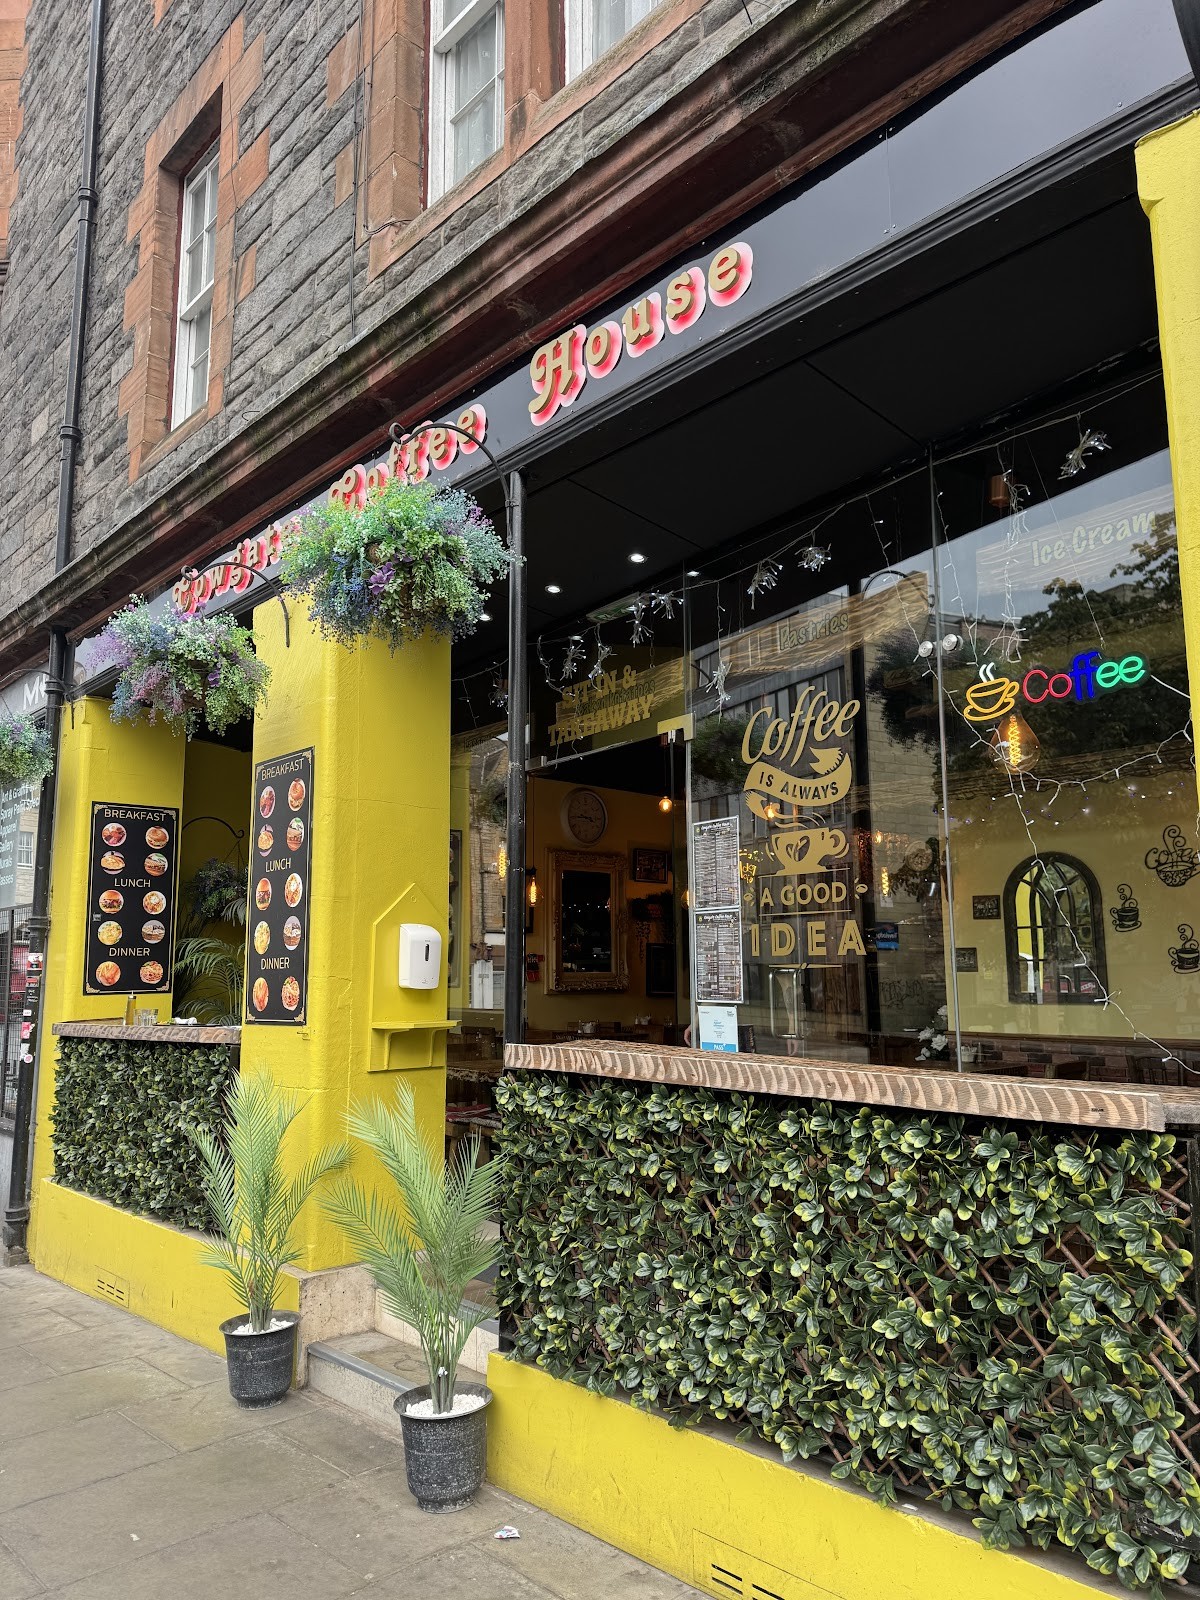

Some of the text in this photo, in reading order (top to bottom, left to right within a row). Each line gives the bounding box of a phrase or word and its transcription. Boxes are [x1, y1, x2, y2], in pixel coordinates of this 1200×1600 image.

[328, 406, 483, 510] Coffee
[528, 245, 748, 420] House
[1032, 510, 1156, 567] Ice Cream
[779, 612, 850, 651] Pastries
[622, 665, 638, 688] &
[1022, 651, 1146, 703] Coffee
[548, 693, 656, 746] TAKEAWAY
[741, 685, 861, 767] Coffee
[261, 758, 305, 781] BREAKFAST
[759, 771, 839, 800] IS ALWAYS
[1, 804, 13, 822] Spray
[104, 808, 166, 822] BREAKFAST
[265, 857, 292, 873] LUNCH
[113, 877, 151, 888] LUNCH
[760, 881, 847, 907] A GOOD
[751, 920, 867, 957] IDEA
[109, 947, 151, 957] DINNER
[260, 957, 290, 970] DINNER
